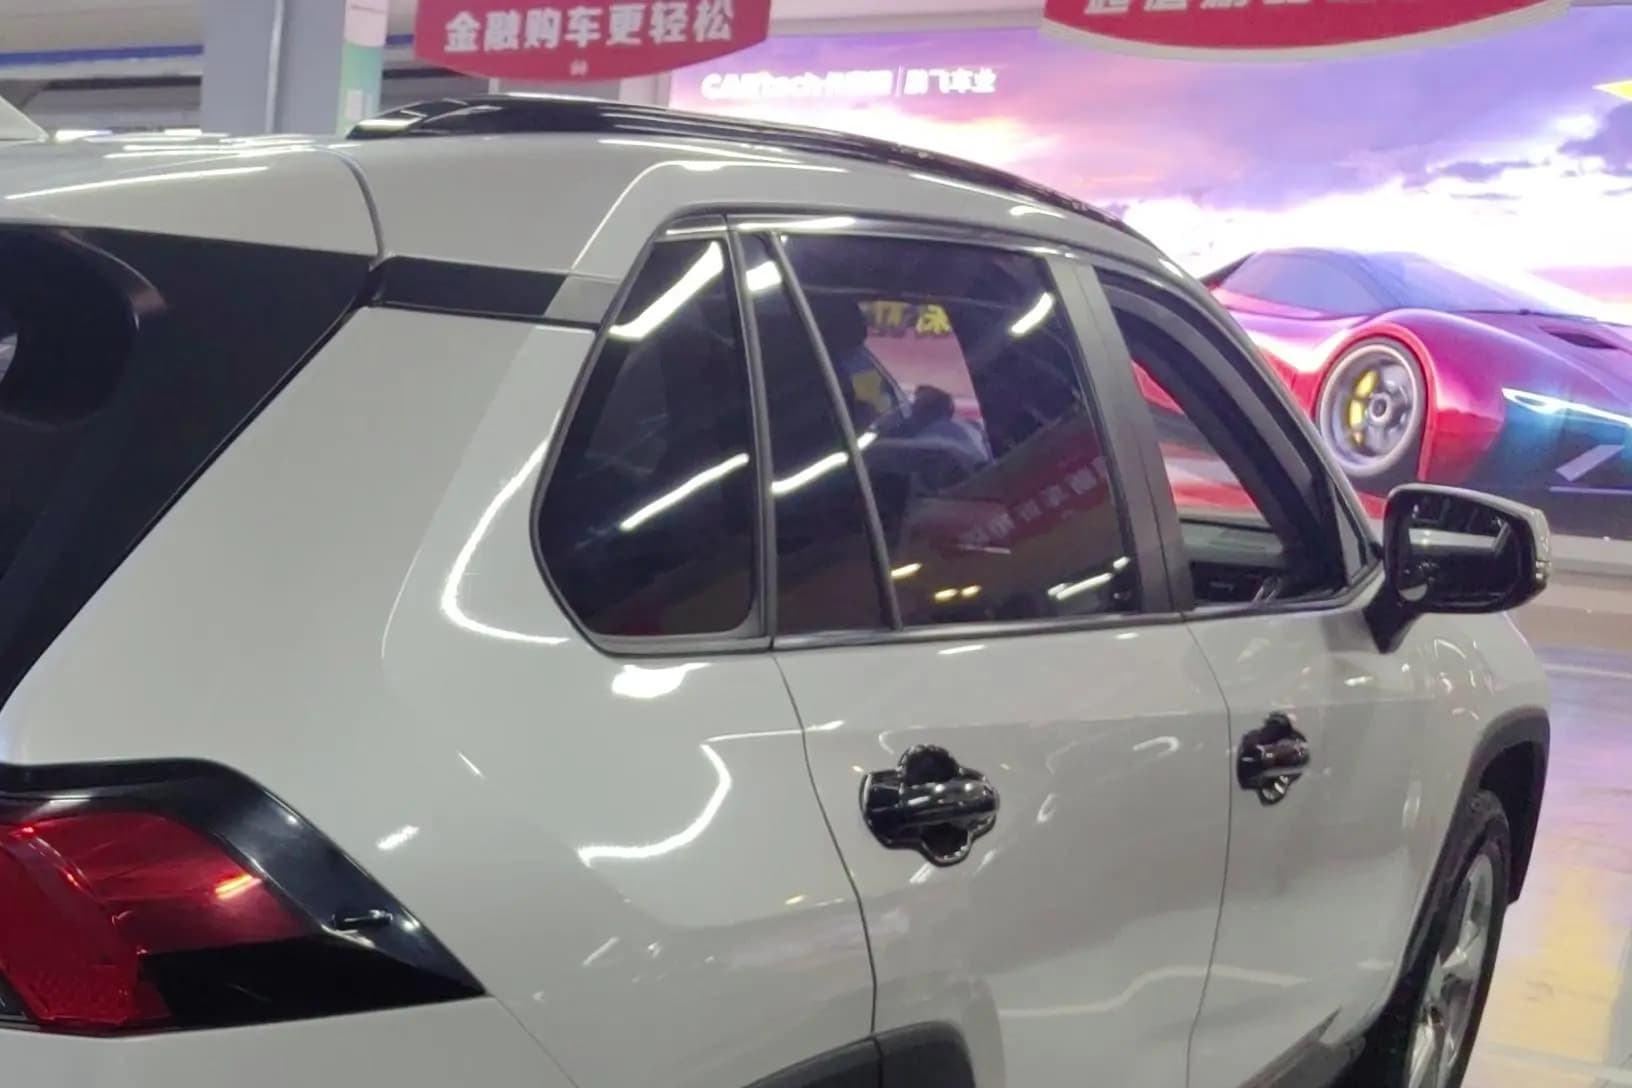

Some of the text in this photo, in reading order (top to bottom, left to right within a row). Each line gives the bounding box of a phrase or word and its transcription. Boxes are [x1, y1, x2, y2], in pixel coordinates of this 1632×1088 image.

[444, 0, 734, 52] 金融购车更轻松
